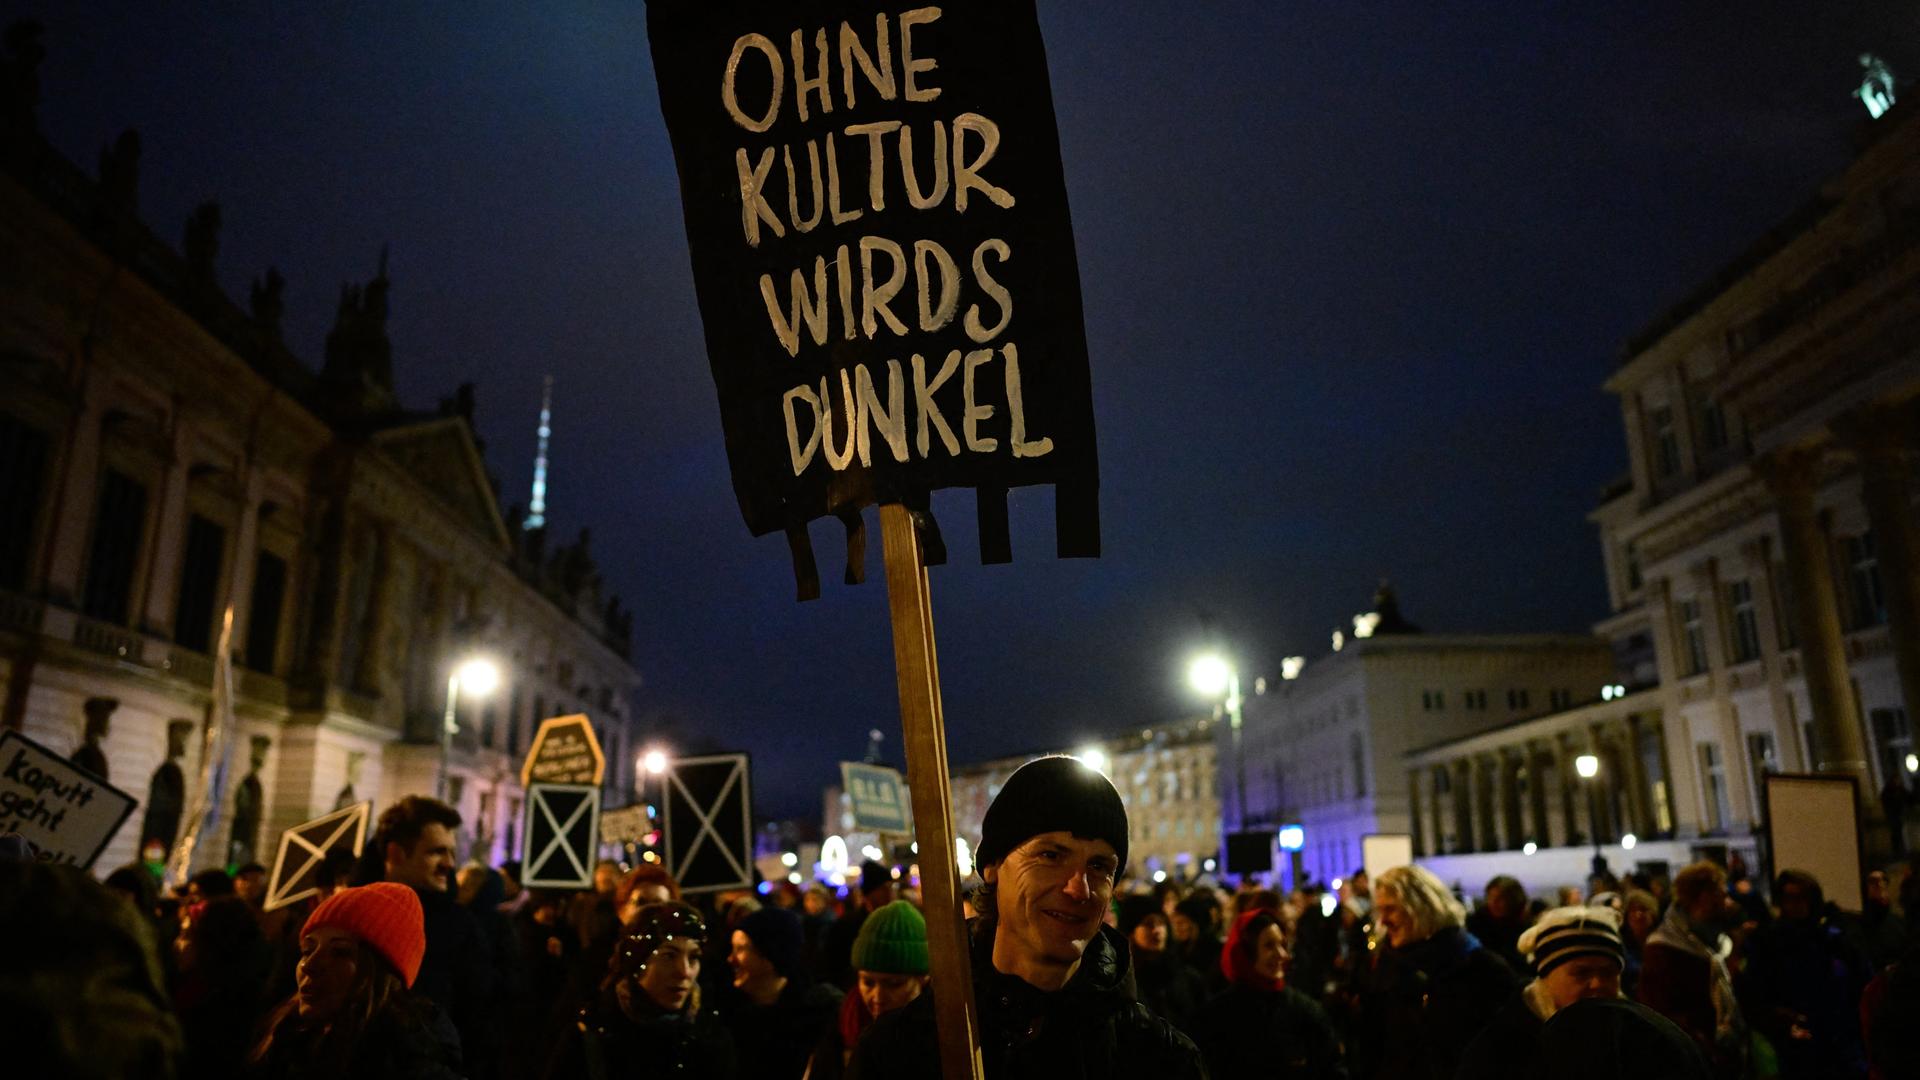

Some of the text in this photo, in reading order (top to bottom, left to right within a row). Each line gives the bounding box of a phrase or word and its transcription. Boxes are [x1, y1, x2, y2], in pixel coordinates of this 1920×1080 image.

[722, 6, 942, 132] OHNE
[735, 112, 1016, 248] KULTUR
[759, 236, 1013, 358] WIRDS
[783, 342, 1054, 476] DUNKEL
[0, 791, 67, 832] geht
